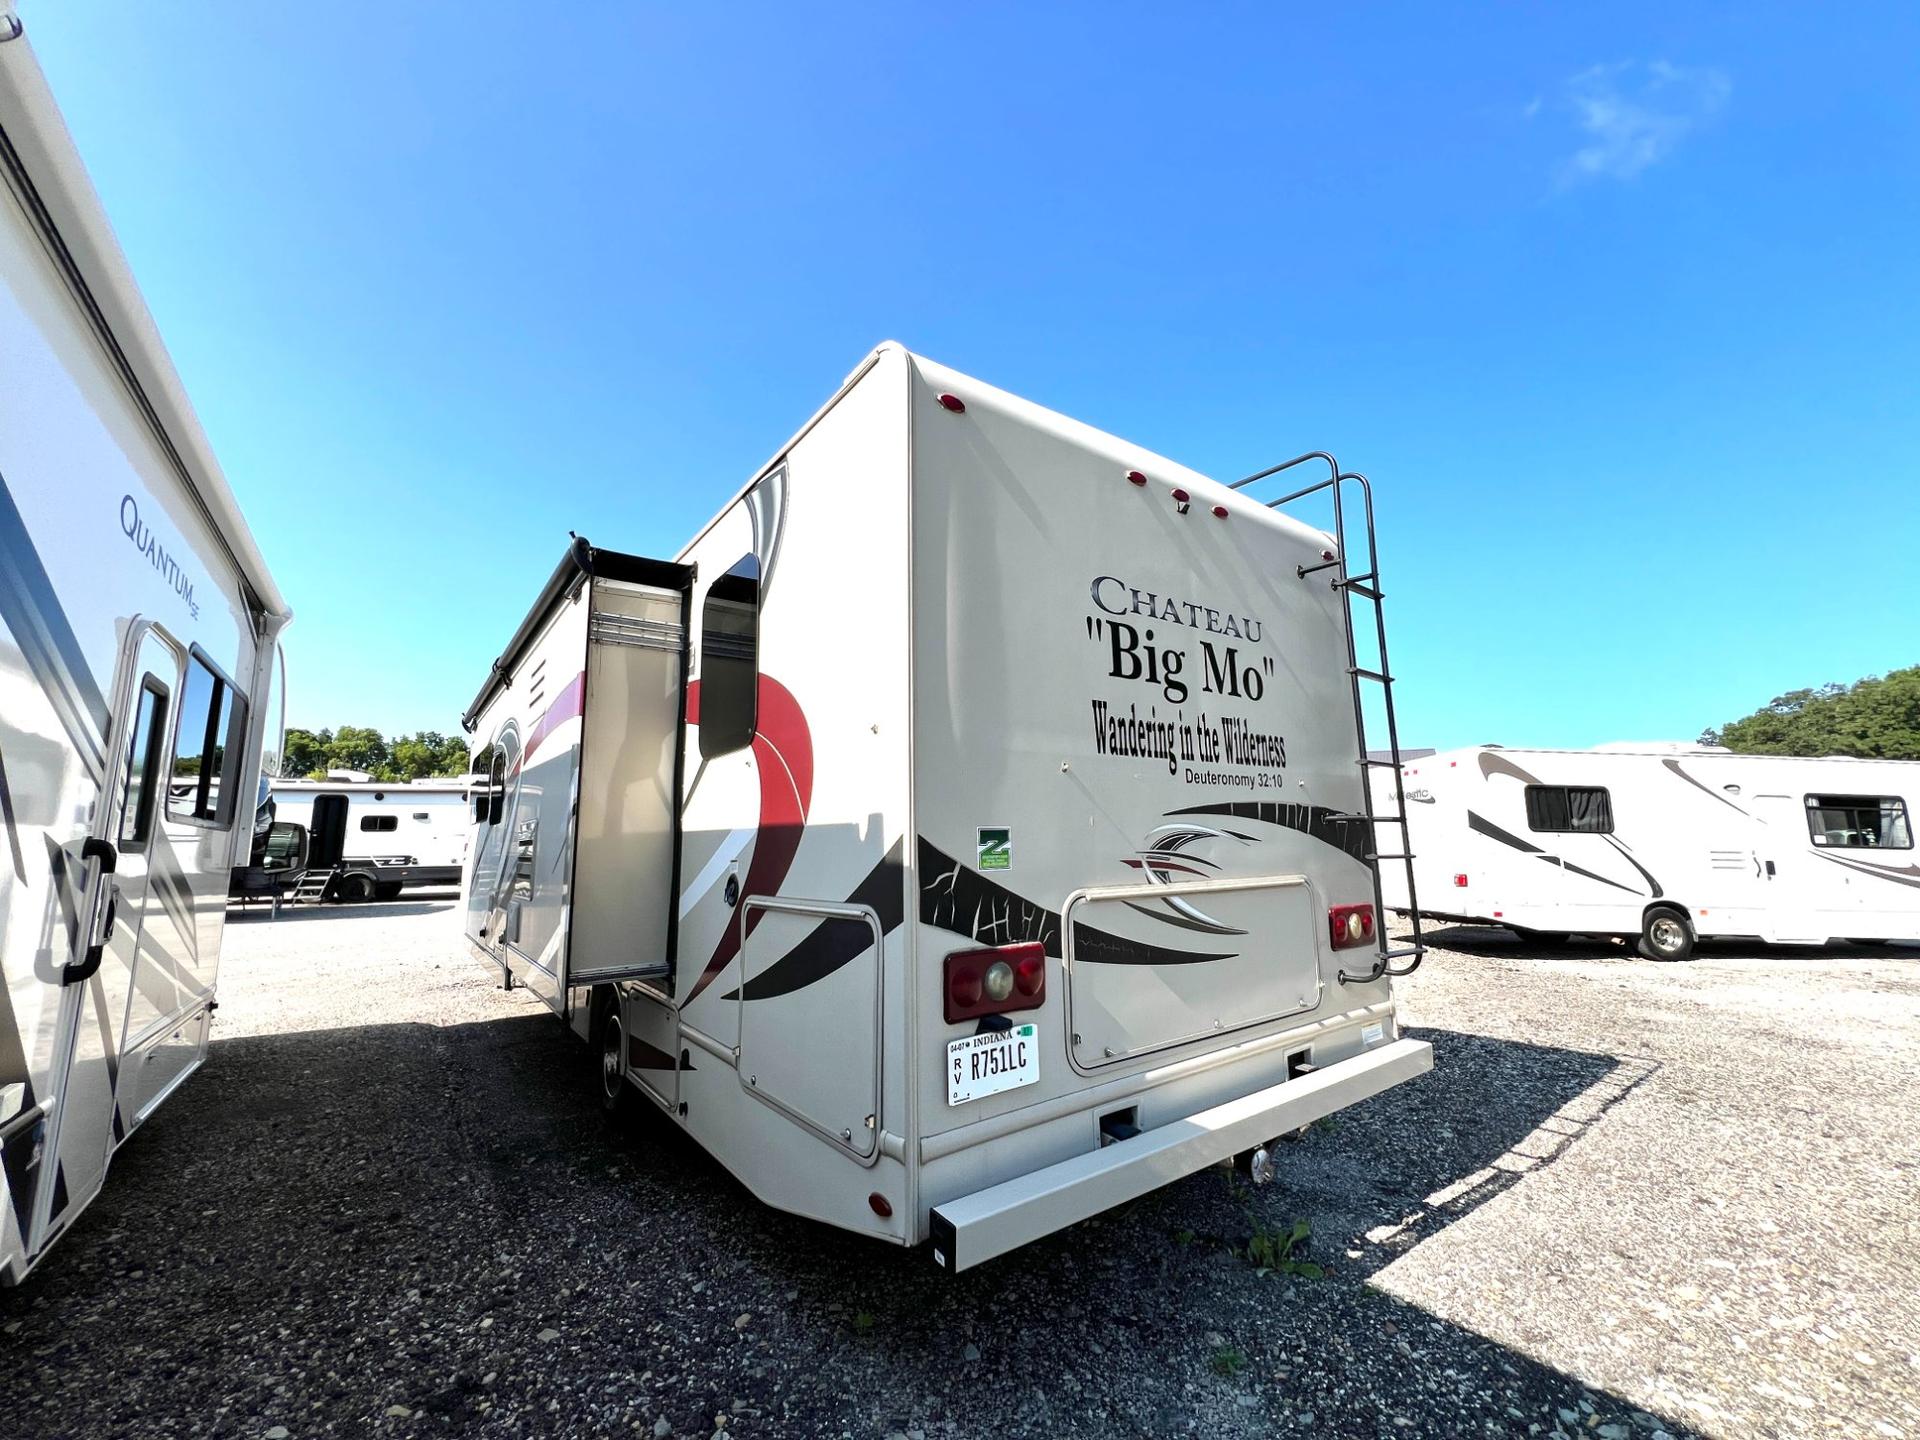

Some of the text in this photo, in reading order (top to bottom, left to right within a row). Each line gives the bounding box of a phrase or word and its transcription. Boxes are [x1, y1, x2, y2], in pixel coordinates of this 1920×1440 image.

[121, 494, 193, 607] QUANTUM
[1090, 575, 1262, 643] CHATEAU
[1086, 616, 1275, 704] "Big Mo"
[1091, 699, 1287, 775] Wandering in the Wilderness
[1185, 768, 1283, 790] Deuteronomy 32:10
[971, 1041, 1027, 1081] R751LC
[973, 1031, 1013, 1048] INDIANA
